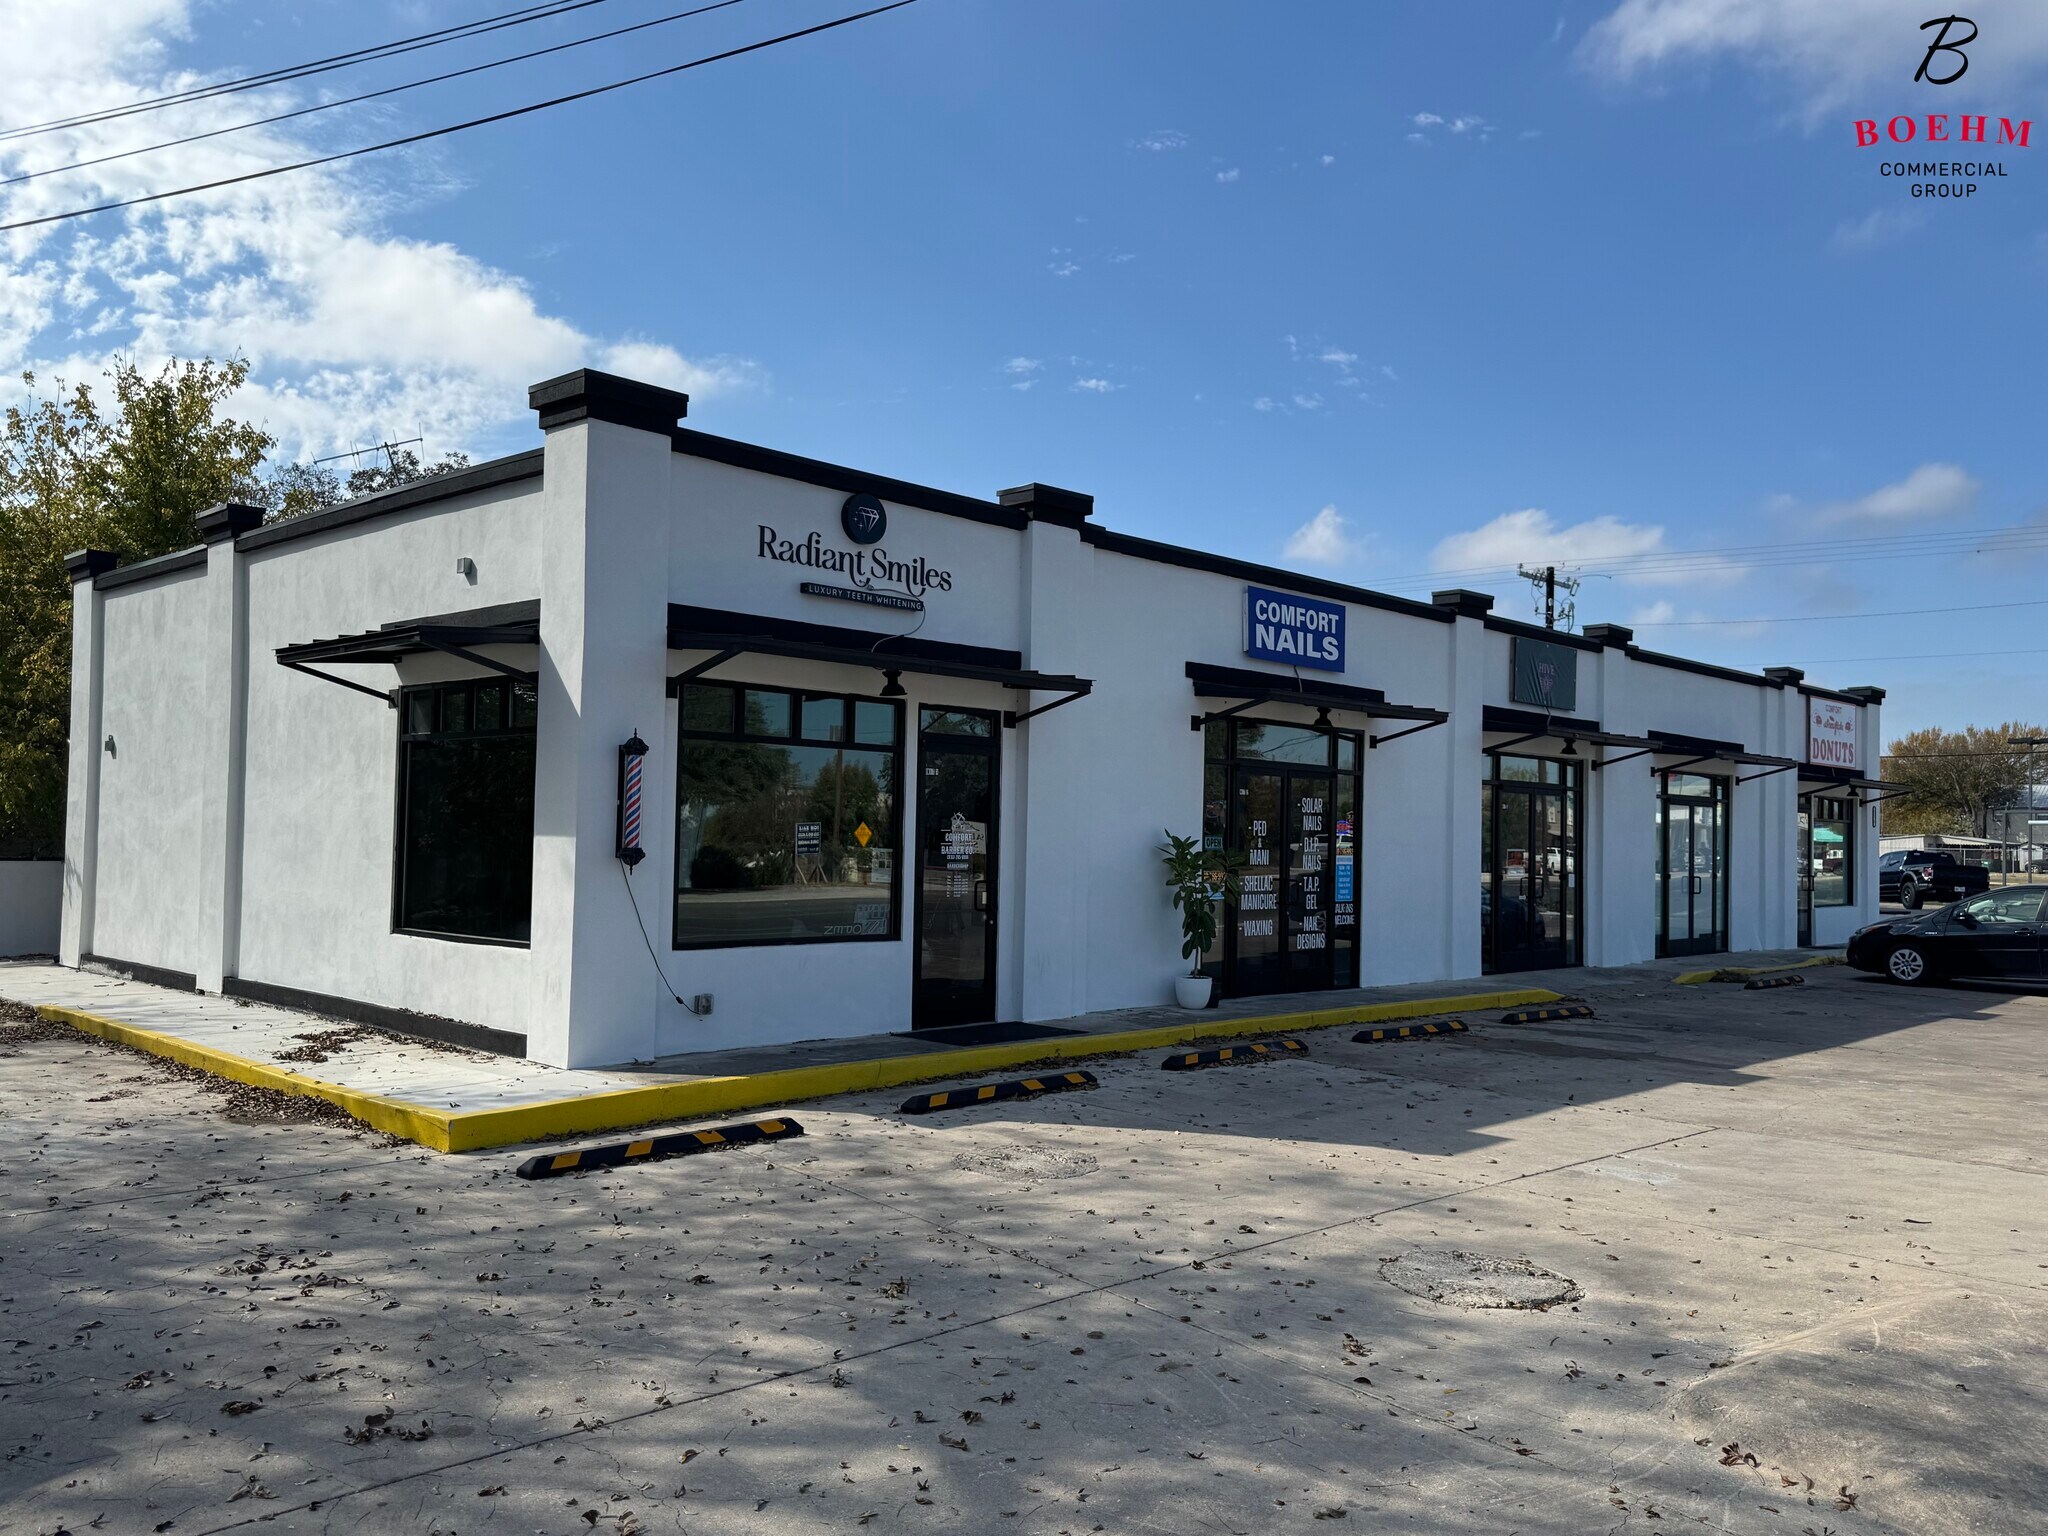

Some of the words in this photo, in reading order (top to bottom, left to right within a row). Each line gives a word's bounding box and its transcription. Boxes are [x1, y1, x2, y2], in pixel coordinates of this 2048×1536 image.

[757, 525, 870, 587] Radiant
[871, 548, 952, 597] Smiles
[809, 584, 843, 598] LUXURY
[847, 591, 873, 602] TEETH
[876, 595, 922, 610] WHITENING
[1255, 599, 1339, 634] COMFORT
[1255, 623, 1339, 661] NAILS
[1812, 737, 1854, 763] DONUTS
[1301, 798, 1323, 814] SOLAR
[1253, 820, 1267, 837] PED
[1303, 815, 1322, 831] NAILS
[945, 832, 972, 842] COMFORT
[1206, 838, 1221, 847] OPEN
[941, 846, 964, 855] BARBER
[1250, 849, 1269, 866] MANI
[1302, 854, 1321, 870] NAILS
[1244, 875, 1273, 891] SHELLAC
[1303, 877, 1320, 892] T.A.P.
[1241, 893, 1277, 910] MANICURE
[1306, 894, 1317, 910] GEL
[1335, 903, 1354, 914] ALK-INS
[1243, 919, 1273, 936] WAXING
[1297, 932, 1326, 949] DESIGNS
